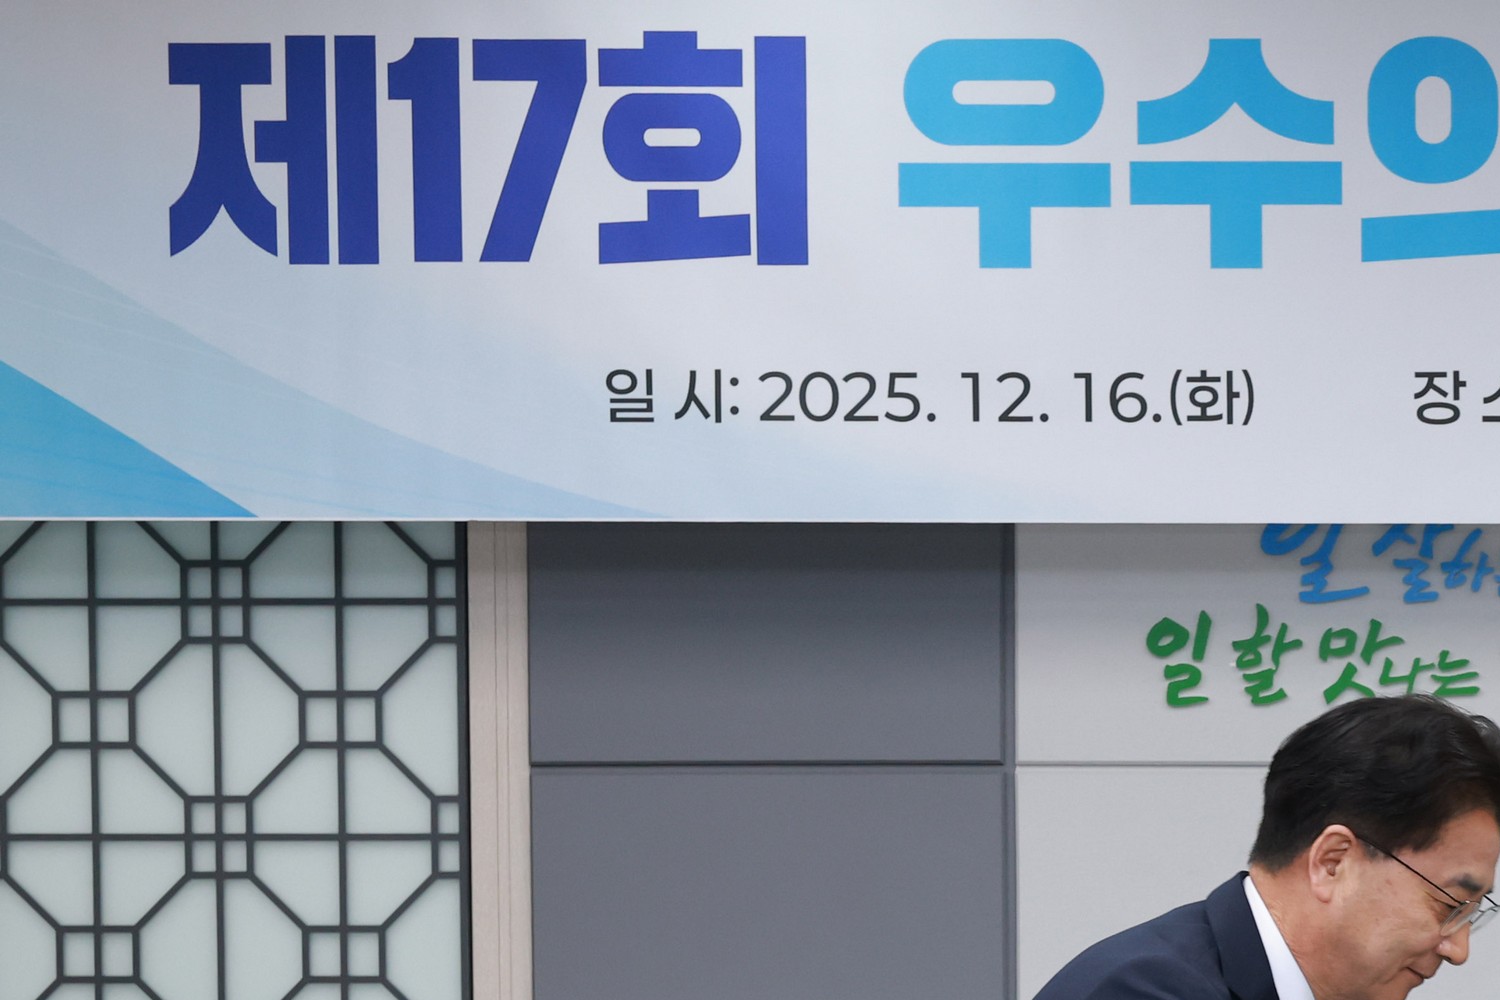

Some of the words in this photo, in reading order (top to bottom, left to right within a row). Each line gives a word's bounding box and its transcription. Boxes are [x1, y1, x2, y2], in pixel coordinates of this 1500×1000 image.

[168, 31, 808, 266] 제17회
[605, 368, 655, 423] 일
[674, 369, 741, 424] 시:
[758, 371, 937, 423] 2025.
[961, 372, 1049, 423] 12.
[1412, 370, 1467, 425] 장
